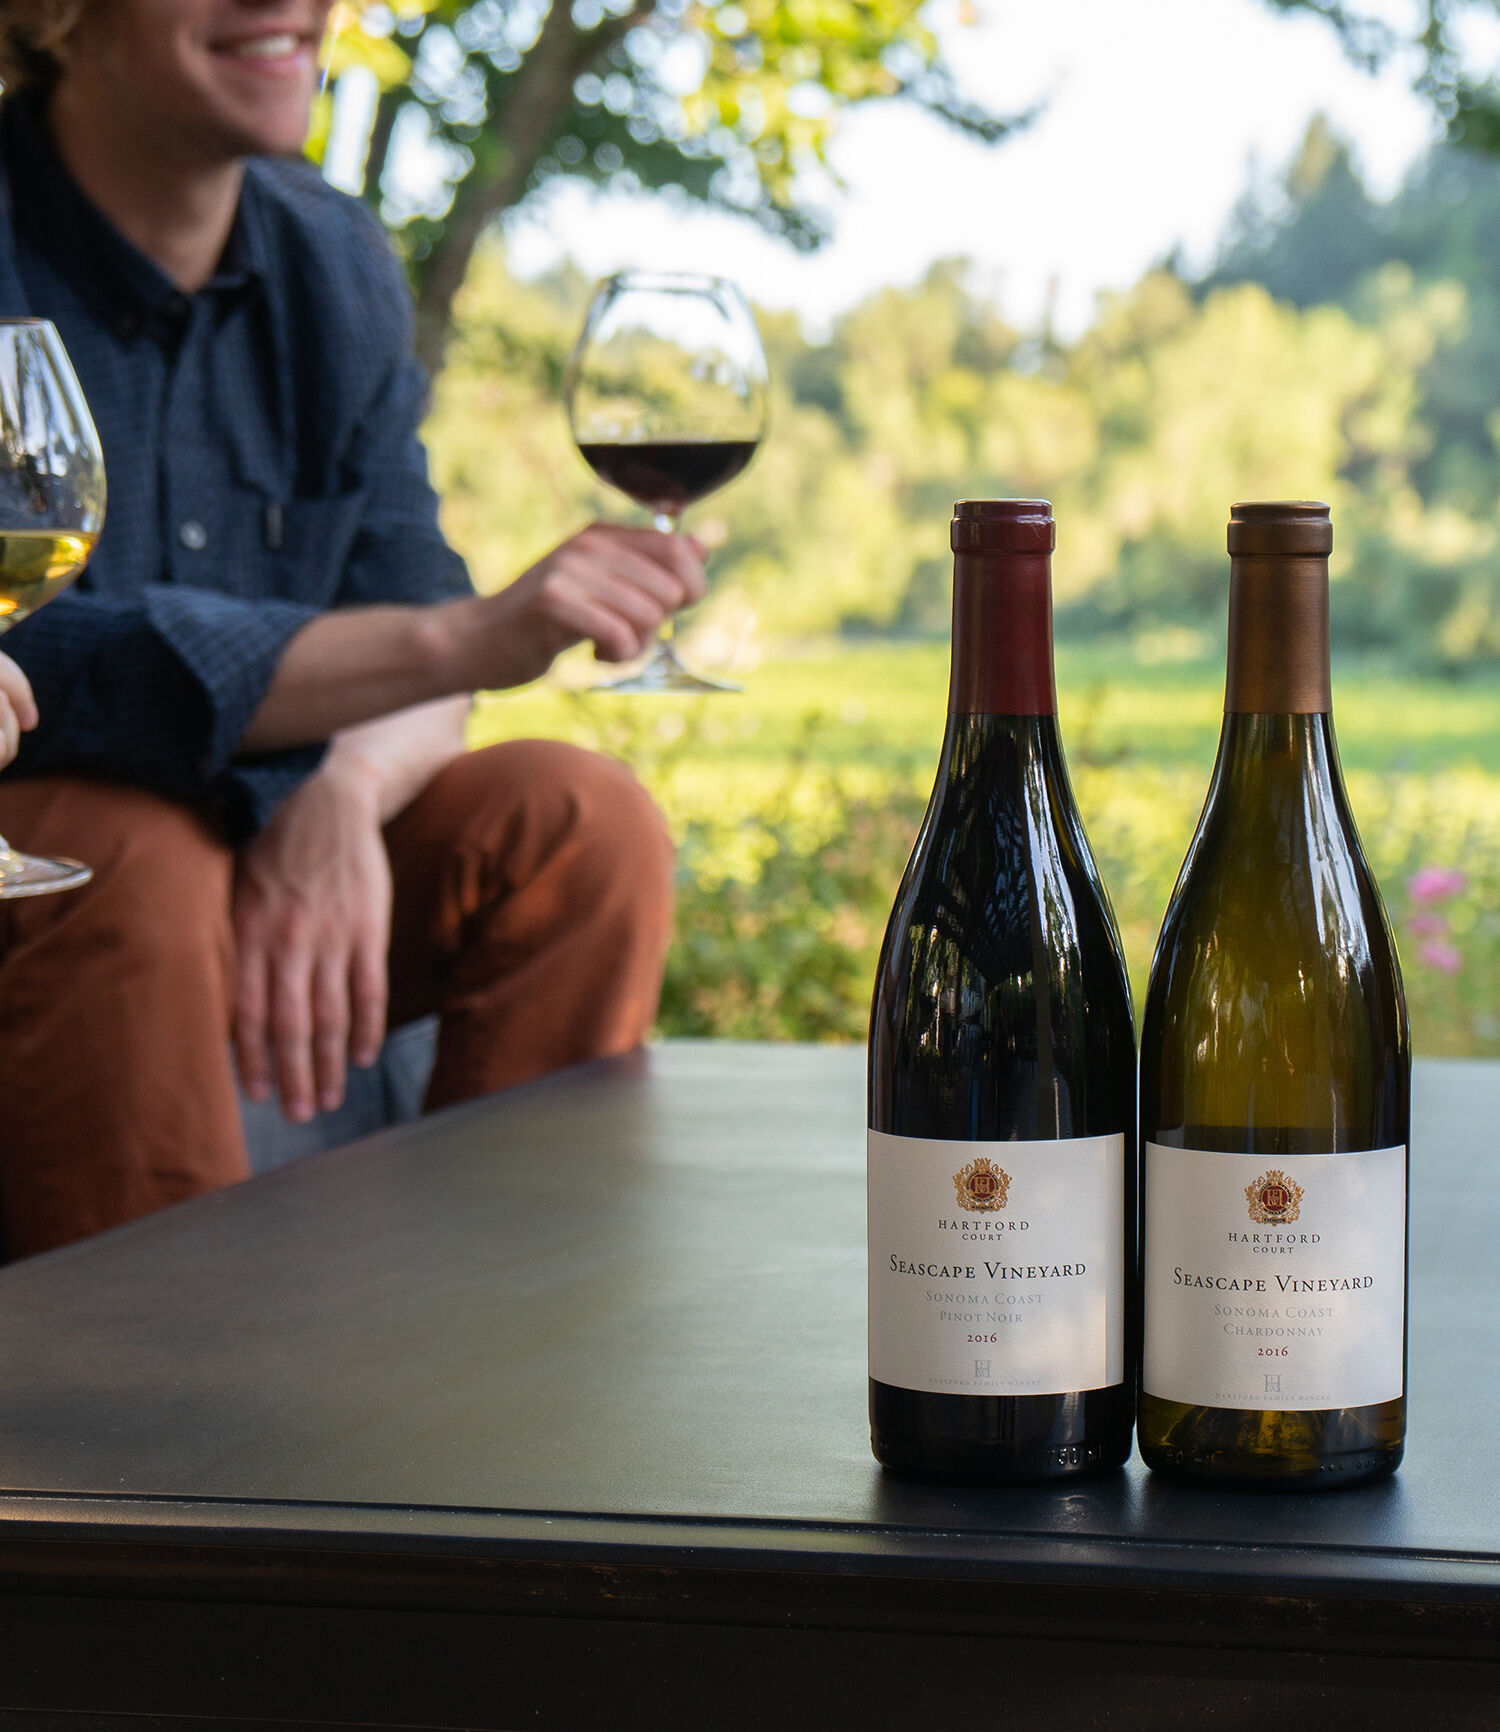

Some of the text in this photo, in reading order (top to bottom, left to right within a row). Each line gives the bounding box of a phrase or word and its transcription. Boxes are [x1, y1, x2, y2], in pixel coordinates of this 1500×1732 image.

[938, 1219, 1030, 1231] HARTFORD
[962, 1233, 1003, 1241] COURT
[1228, 1232, 1321, 1244] HARTFORD
[1253, 1246, 1294, 1254] COURT
[889, 1254, 1087, 1279] SEASCAPE VINEYARD
[1173, 1267, 1374, 1292] SEASCAPE VINEYARD
[926, 1290, 1044, 1305] SONOMA COAST
[1214, 1303, 1335, 1318] SONOMA COAST
[940, 1311, 1023, 1323] PINOT NOIR
[1223, 1323, 1324, 1337] CHARDONNAY
[967, 1332, 998, 1343] 2016
[1257, 1346, 1288, 1357] 2016
